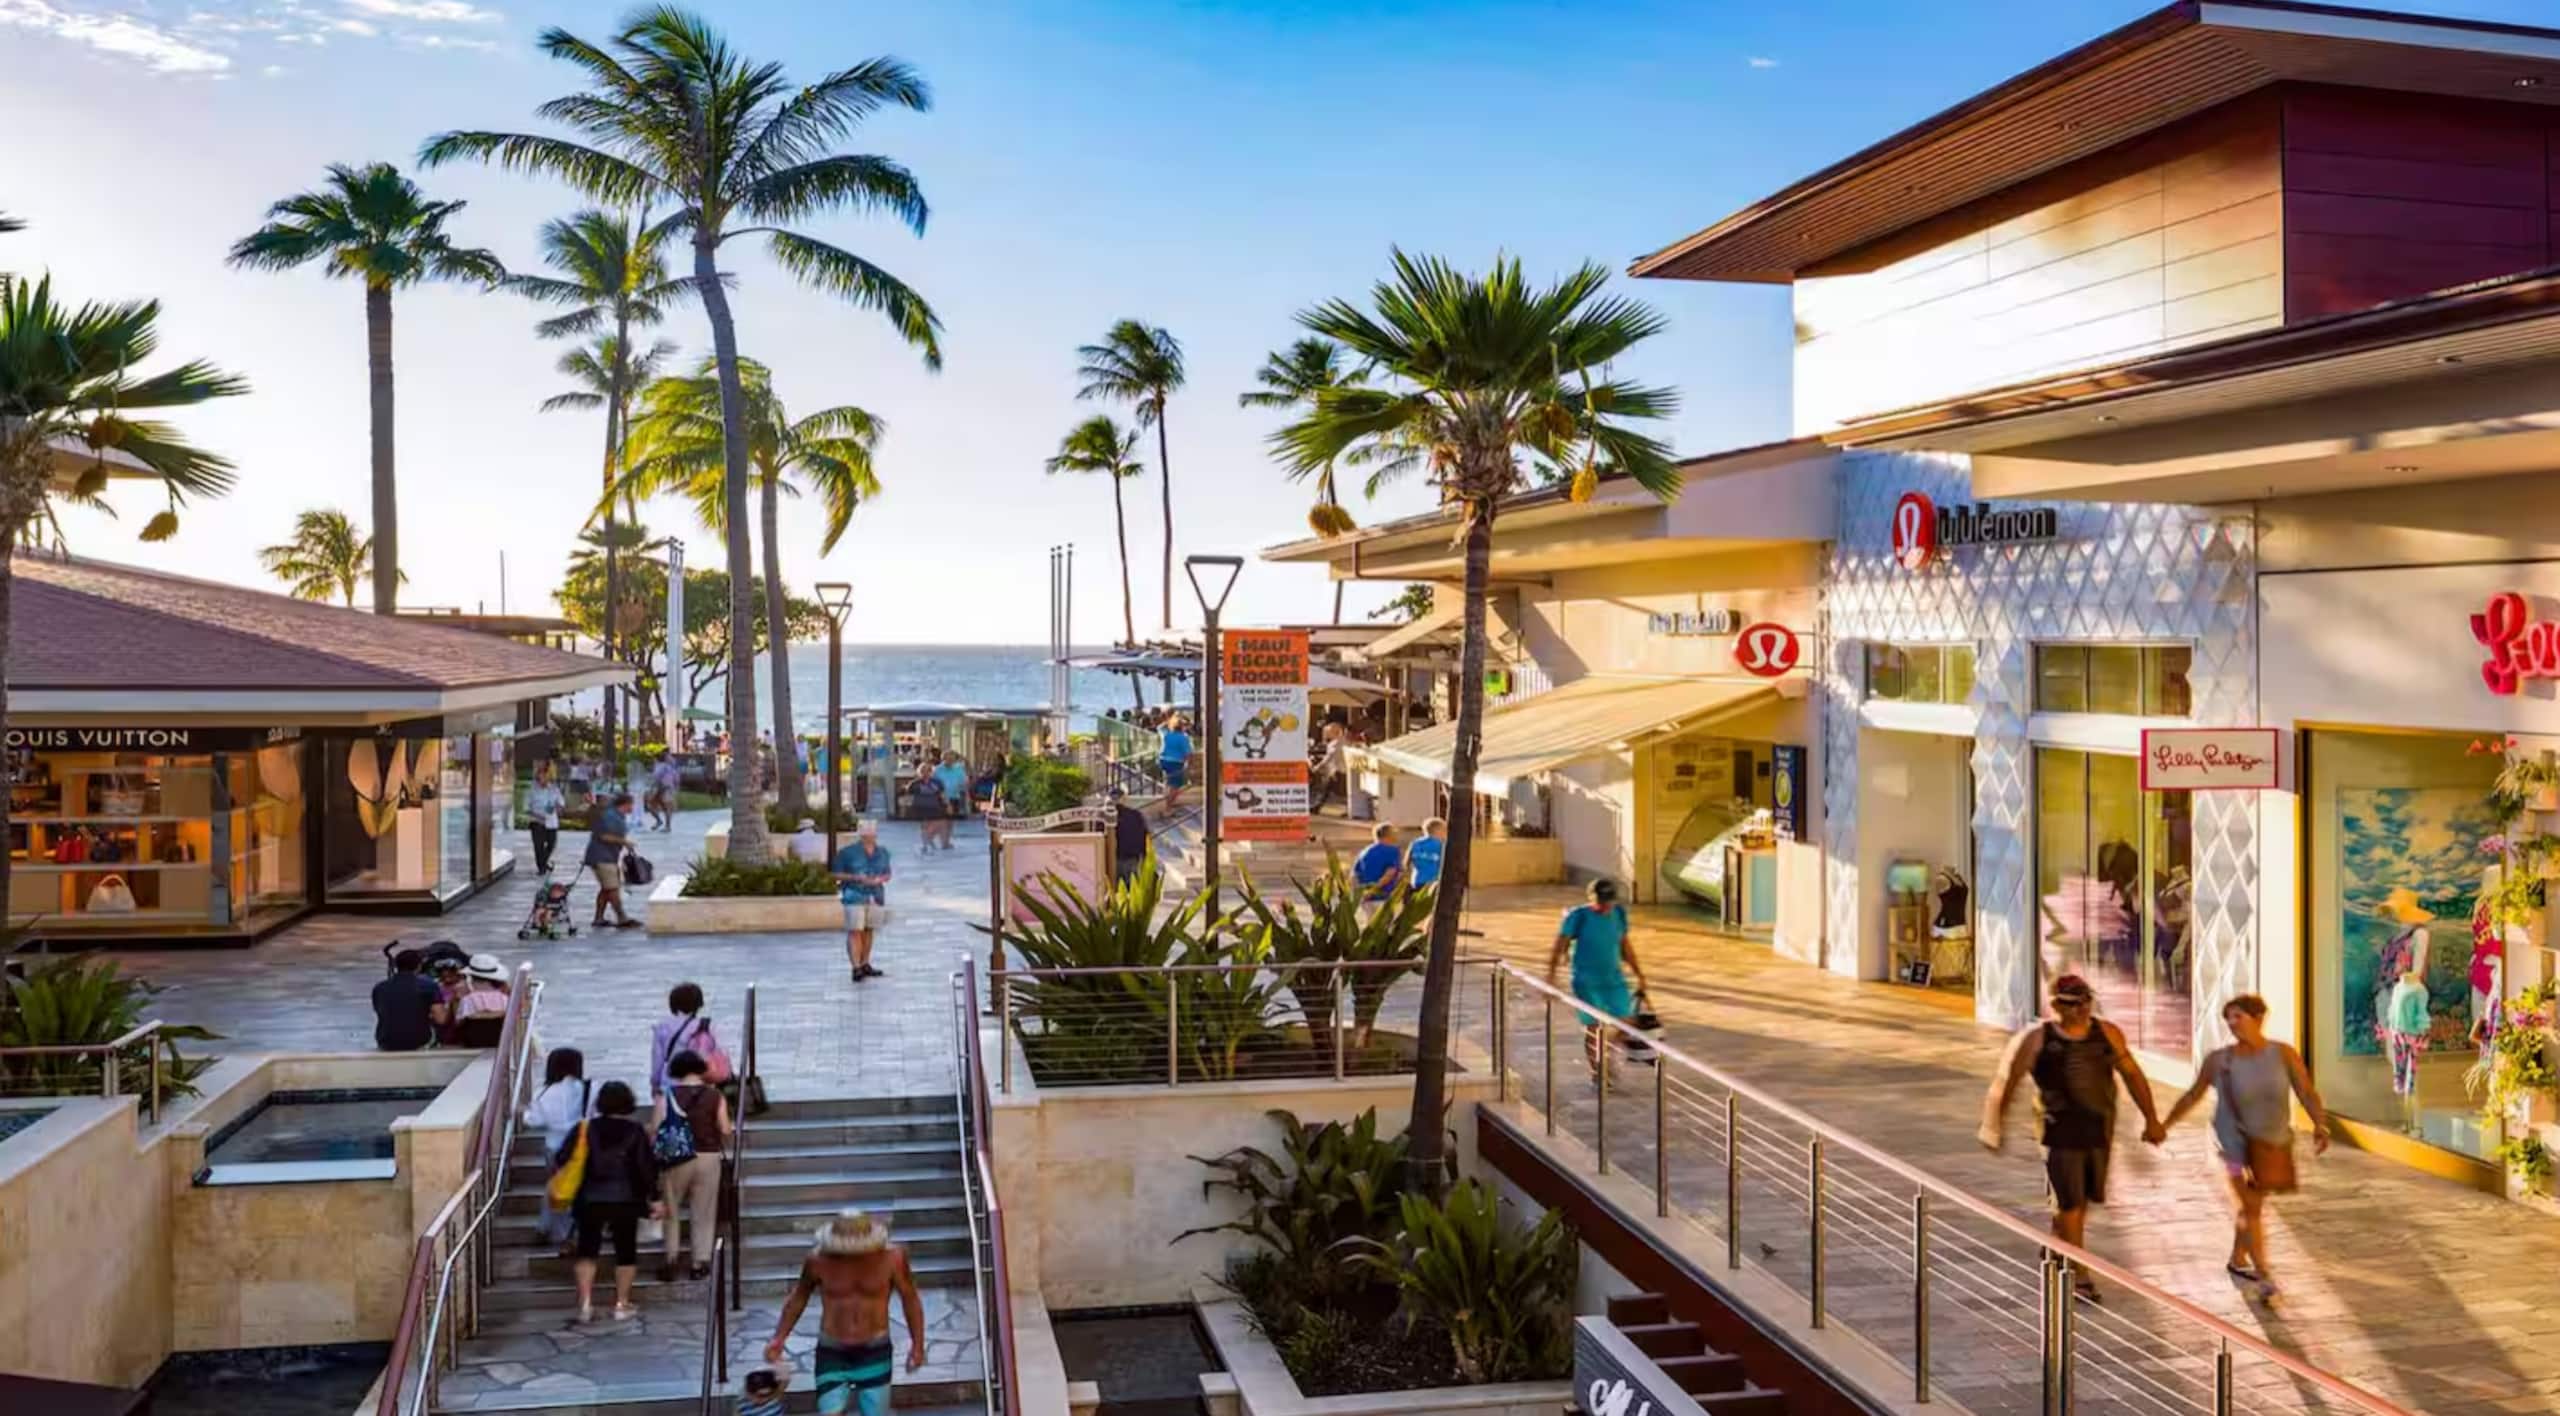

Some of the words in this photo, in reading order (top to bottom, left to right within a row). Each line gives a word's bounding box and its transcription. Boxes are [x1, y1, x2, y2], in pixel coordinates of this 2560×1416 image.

[1936, 504, 2050, 545] lululemon
[1240, 638, 1291, 652] MAUI
[1232, 654, 1299, 668] ESCAPE
[1232, 670, 1299, 684] ROOMS
[5, 730, 69, 747] OUIS
[78, 730, 189, 747] VUITTON
[2153, 744, 2208, 774] Lilly
